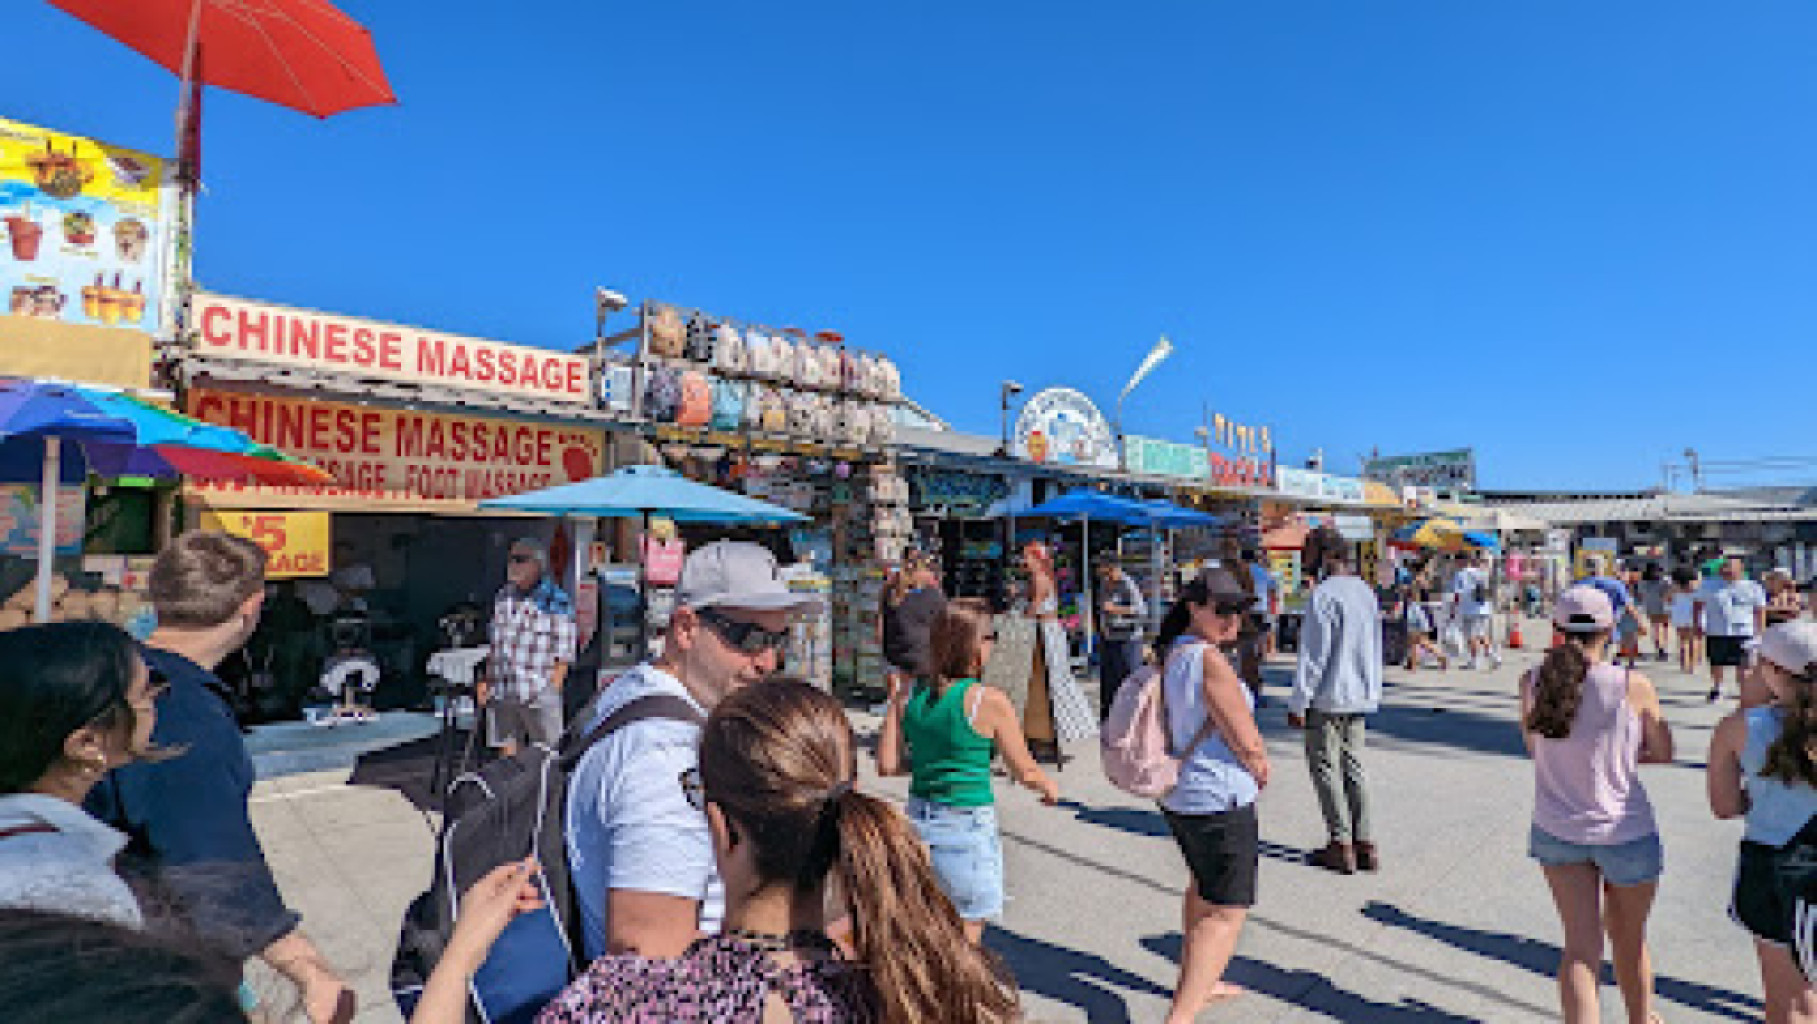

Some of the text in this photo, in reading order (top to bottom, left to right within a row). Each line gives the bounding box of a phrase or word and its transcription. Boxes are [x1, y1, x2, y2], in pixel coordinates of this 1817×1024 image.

[202, 304, 583, 393] CHINESE MASSAGE
[197, 396, 553, 466] CHINESE MASSAGE
